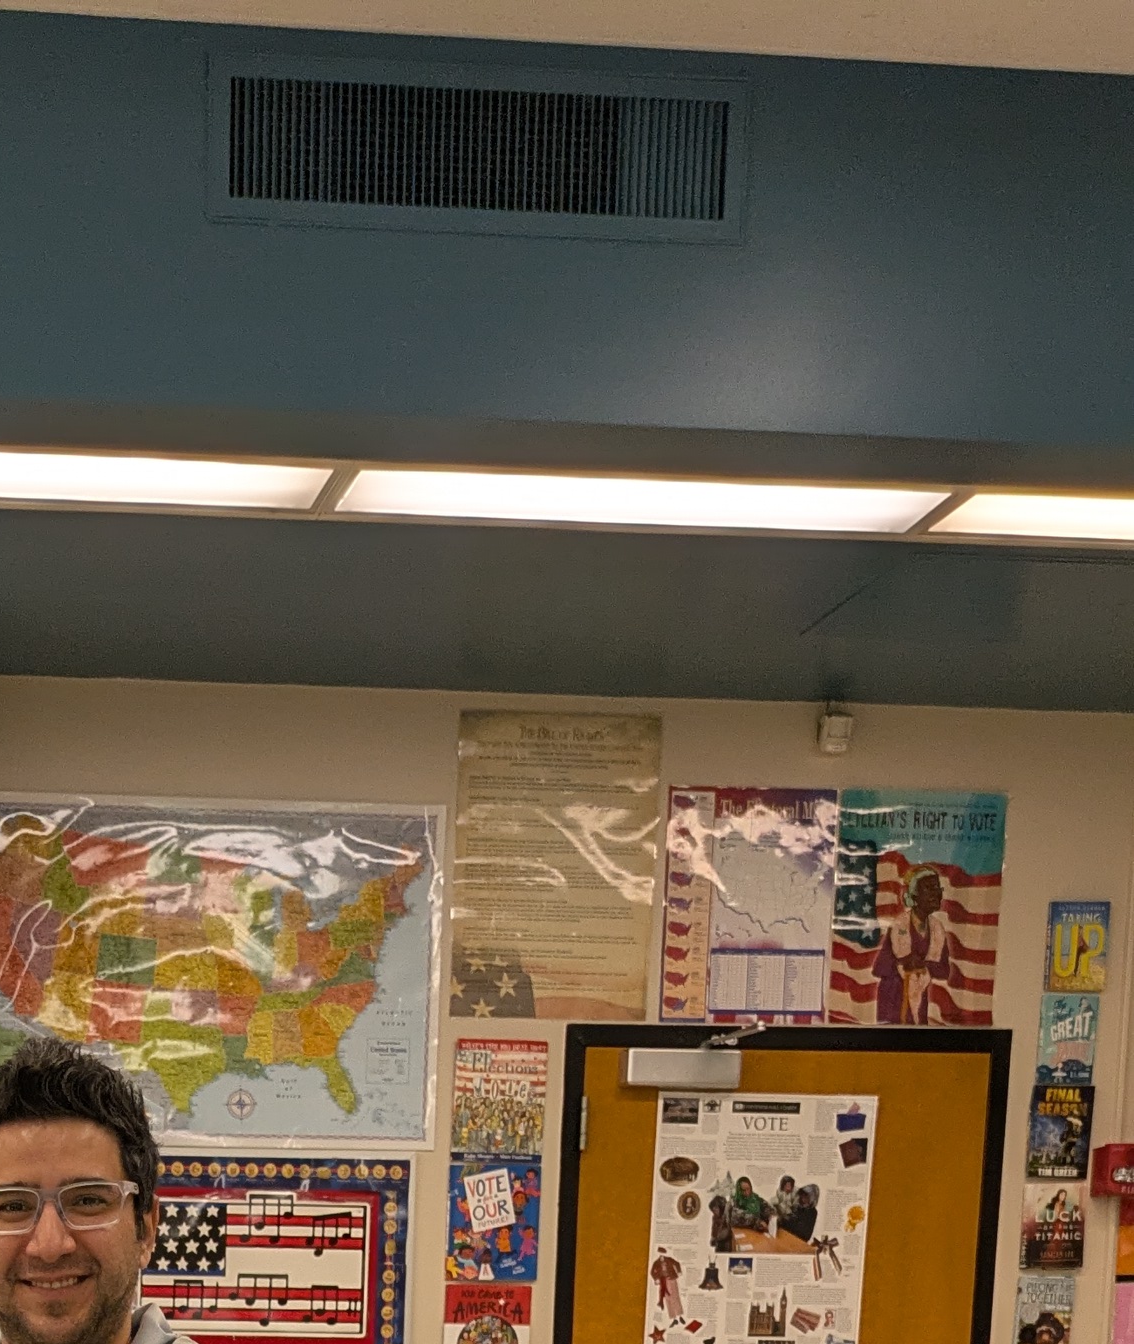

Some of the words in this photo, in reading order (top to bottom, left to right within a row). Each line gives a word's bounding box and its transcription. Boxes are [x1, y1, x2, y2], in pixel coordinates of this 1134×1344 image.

[914, 813, 947, 828] RIGHT
[953, 815, 963, 828] TO
[969, 813, 996, 830] VOTE
[1054, 924, 1105, 977] UP
[1051, 1012, 1092, 1041] GREAT
[1046, 1088, 1081, 1102] FINAL
[743, 1117, 789, 1131] VOTE
[467, 1175, 506, 1197] VOTE
[473, 1200, 509, 1220] OUR
[1035, 1211, 1081, 1222] LUCK
[1035, 1232, 1081, 1240] TITANIC
[453, 1301, 523, 1322] AMERICA
